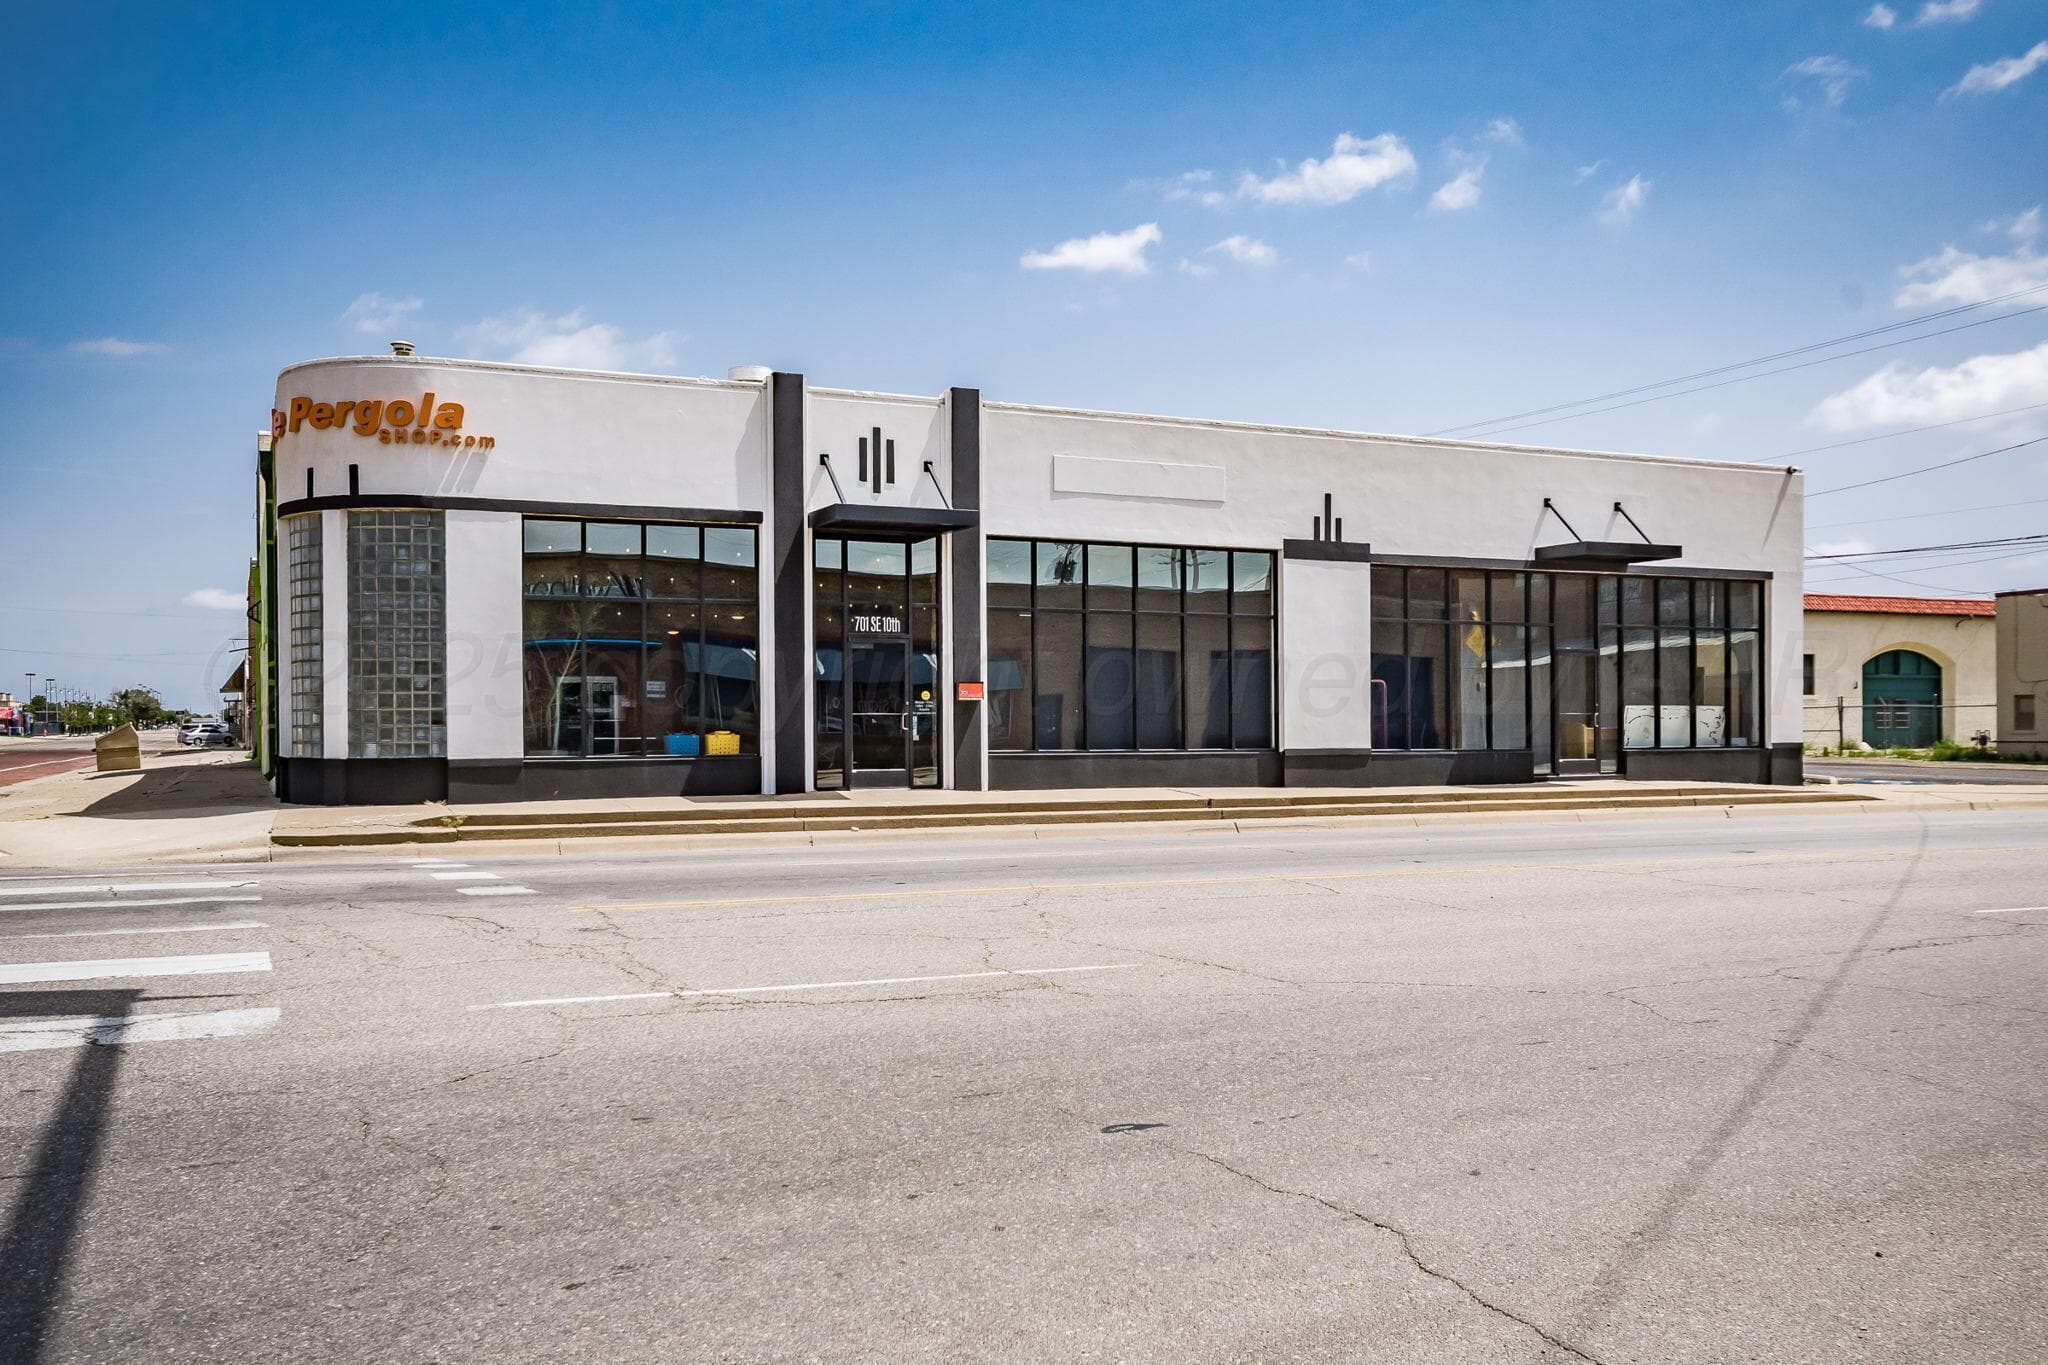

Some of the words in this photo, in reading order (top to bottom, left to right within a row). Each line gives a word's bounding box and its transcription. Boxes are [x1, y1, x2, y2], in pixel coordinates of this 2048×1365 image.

[287, 392, 465, 437] Pergola
[854, 616, 869, 632] 701
[870, 616, 882, 632] SE
[882, 616, 901, 633] 10th
